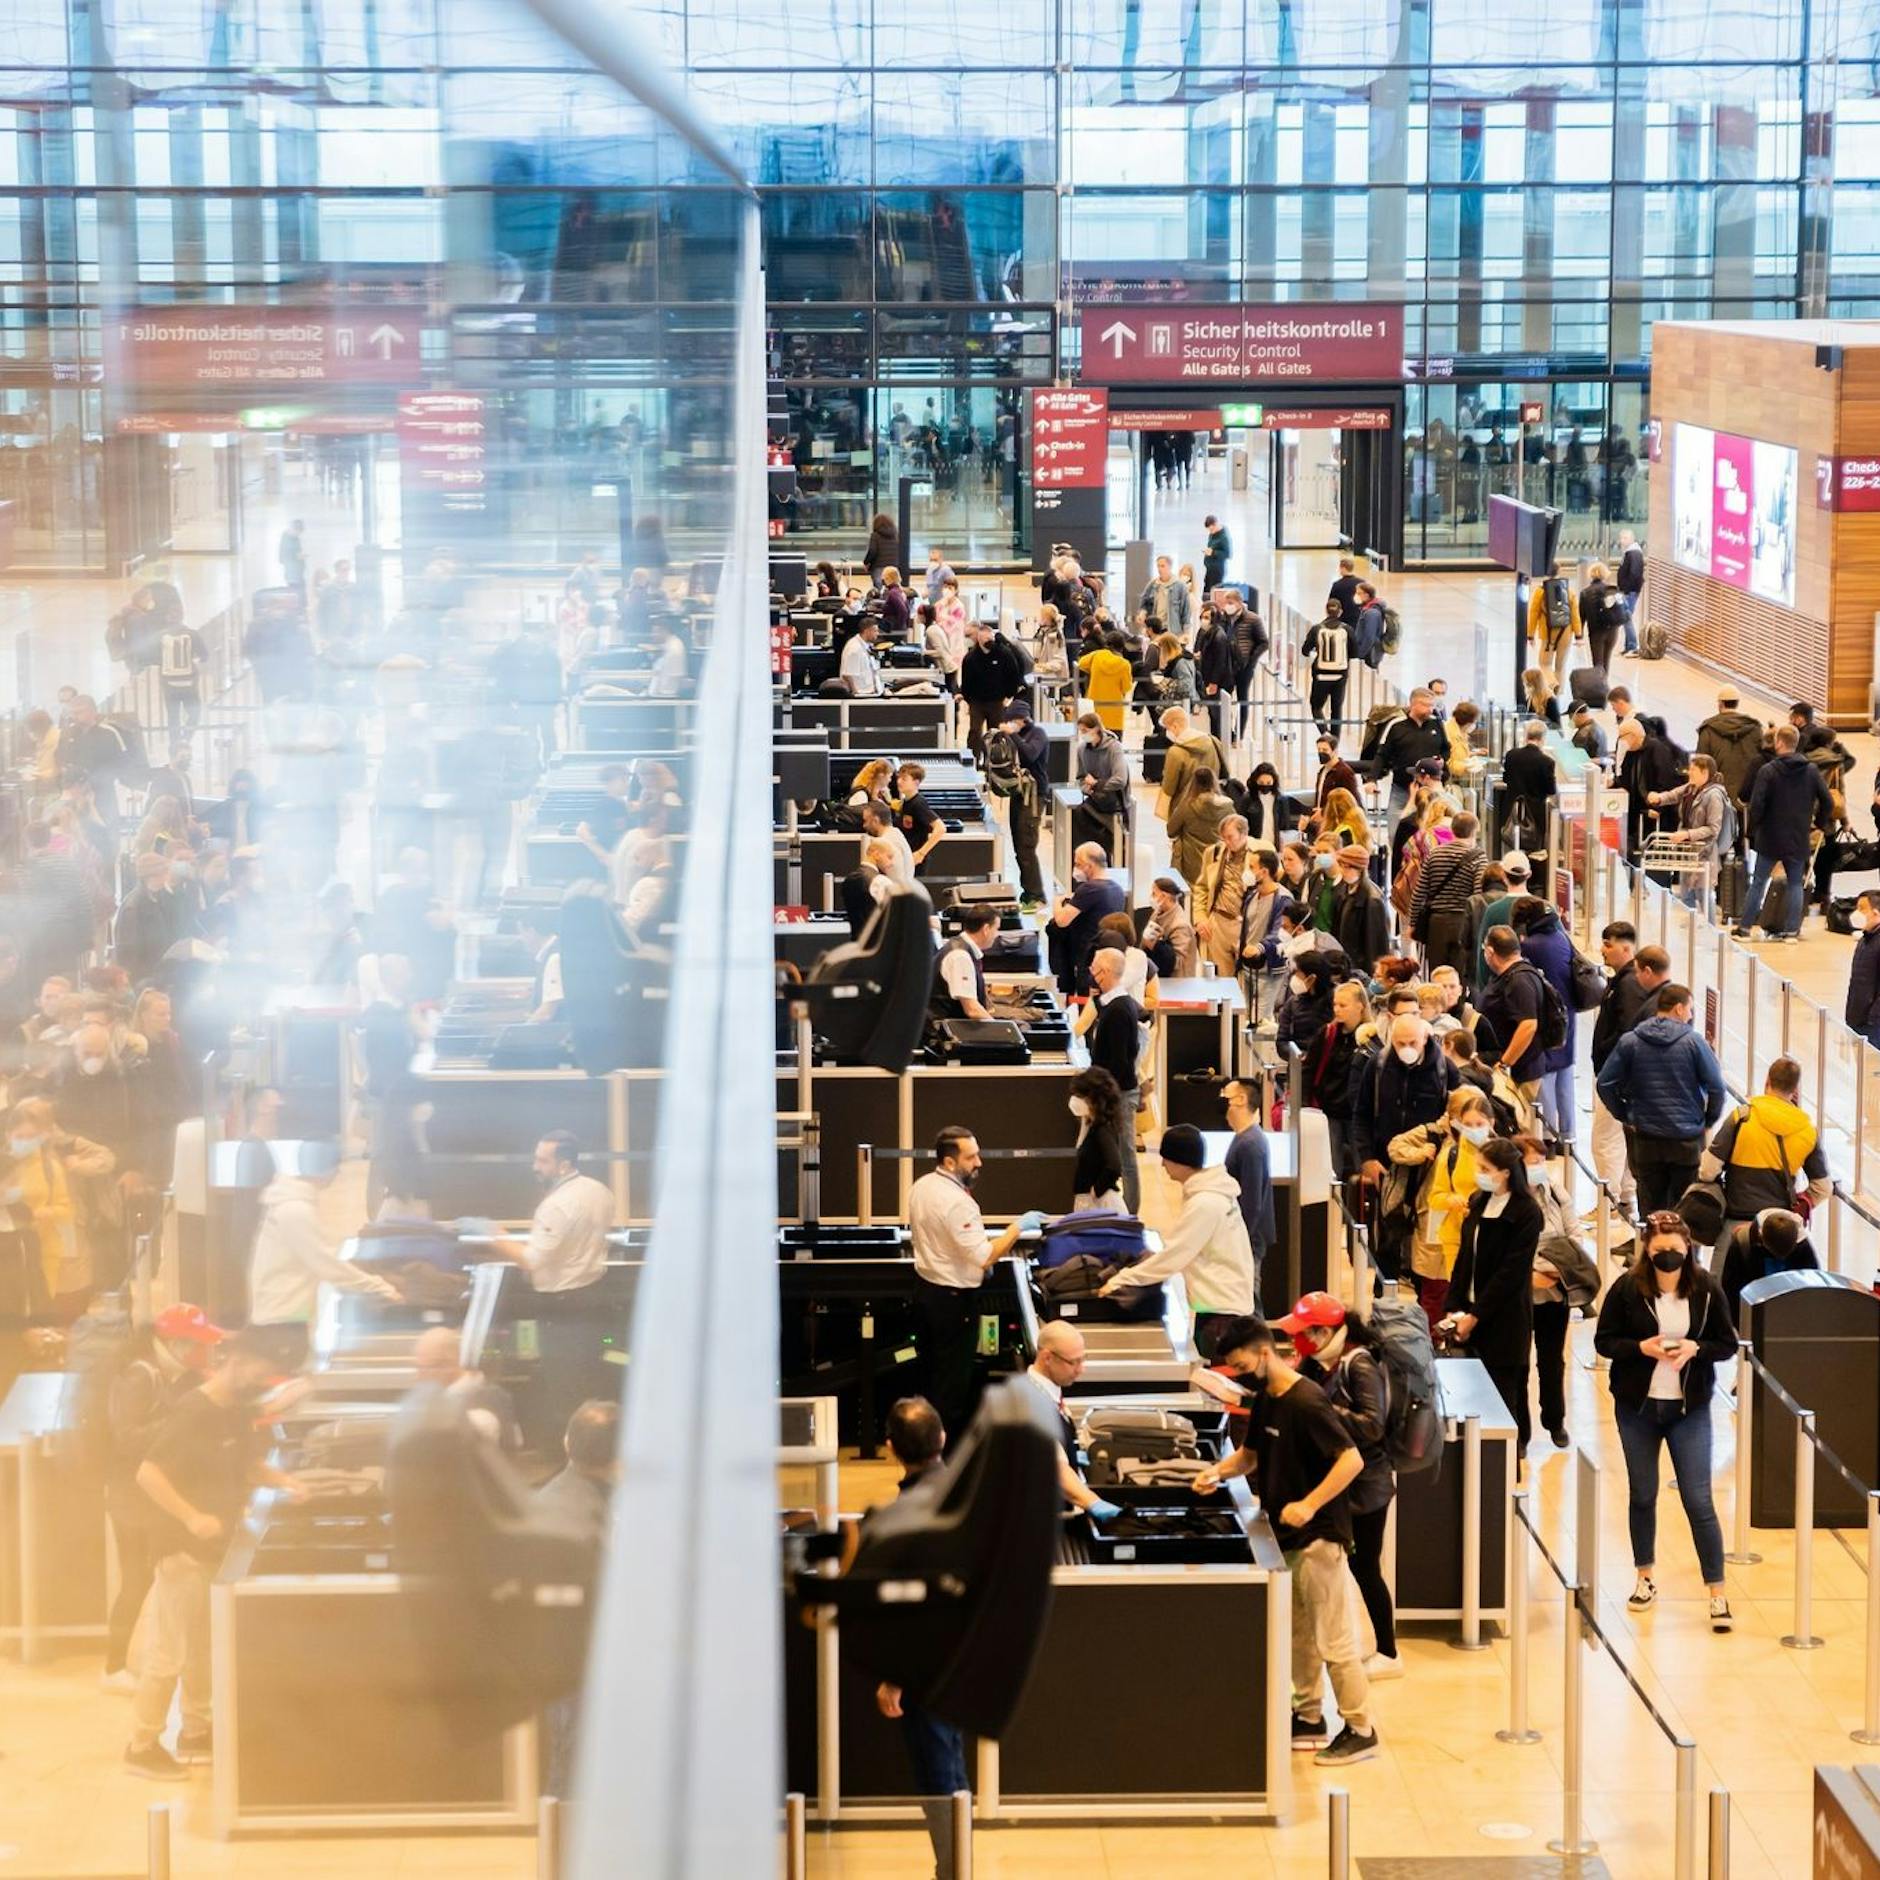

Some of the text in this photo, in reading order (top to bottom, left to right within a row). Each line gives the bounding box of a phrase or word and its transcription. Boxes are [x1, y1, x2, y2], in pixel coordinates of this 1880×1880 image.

[1183, 321, 1386, 339] Sicherheitskontrolle 1
[1183, 344, 1301, 361] Security Control
[1182, 363, 1312, 376] Alle Gates All Gates
